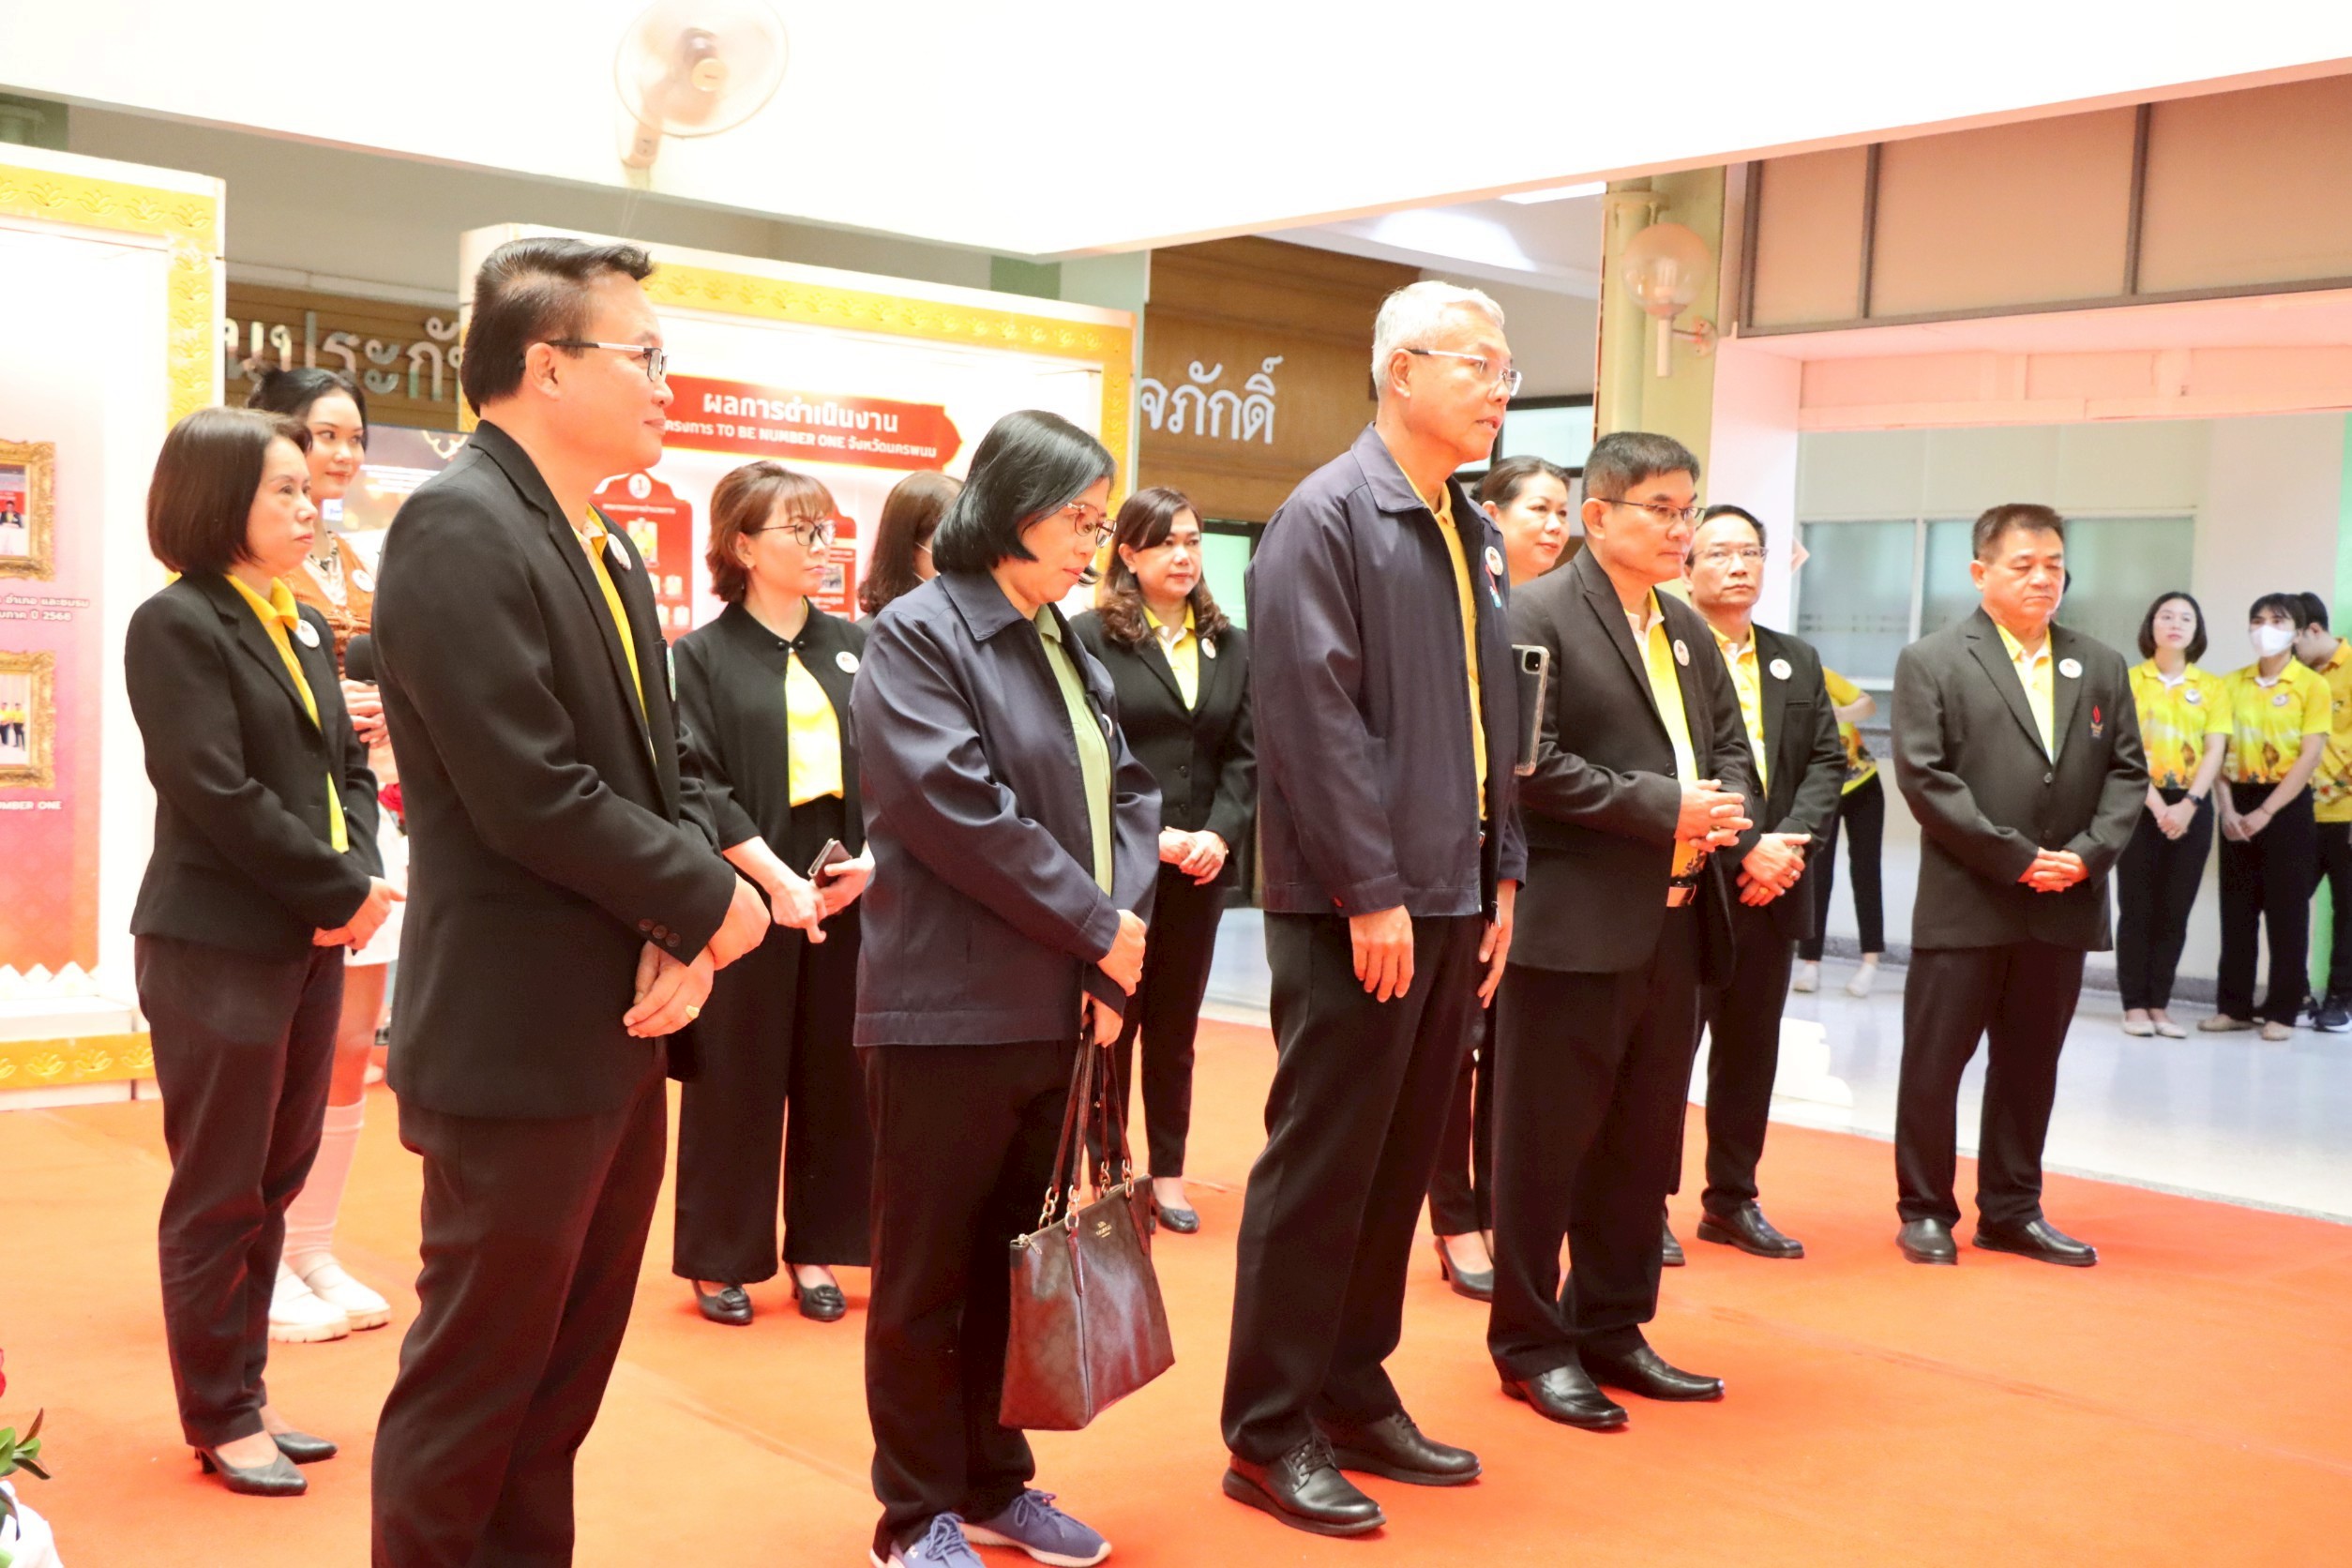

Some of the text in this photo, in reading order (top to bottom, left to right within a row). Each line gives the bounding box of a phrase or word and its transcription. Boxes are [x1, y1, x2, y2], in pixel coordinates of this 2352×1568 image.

[703, 392, 898, 433] ผลการดำเนินงาน
[664, 419, 714, 435] ครงการ
[716, 423, 735, 437] TO
[738, 426, 757, 440] BE
[759, 428, 816, 446] NUMBER
[818, 433, 846, 449] ONE
[38, 801, 62, 810] ONE
